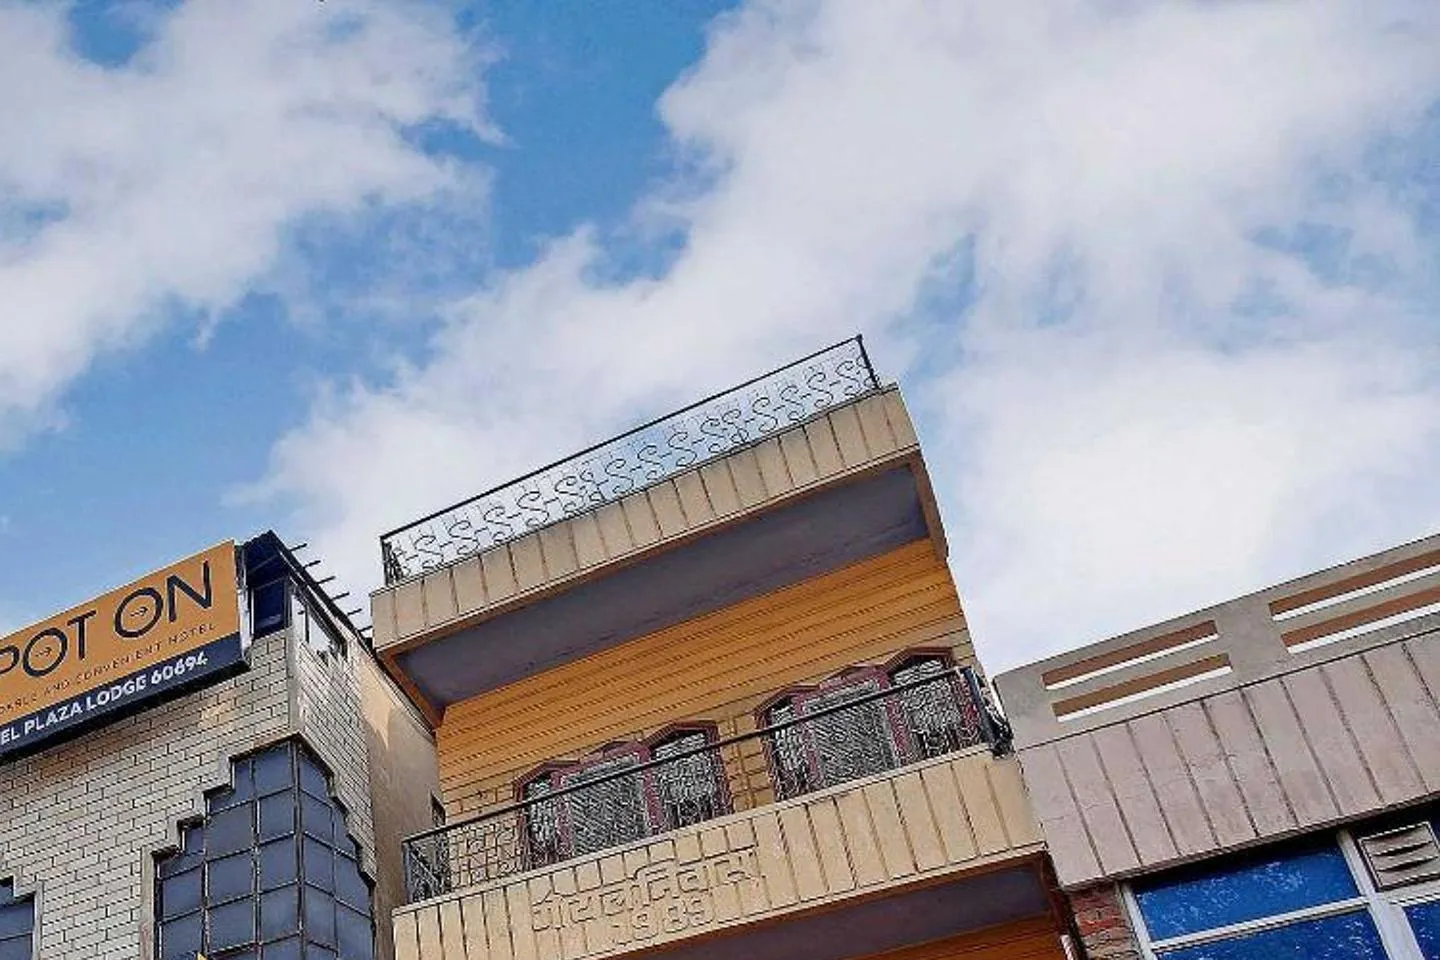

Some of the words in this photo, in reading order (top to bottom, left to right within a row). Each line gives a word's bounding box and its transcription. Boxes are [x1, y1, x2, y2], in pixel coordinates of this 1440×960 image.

[114, 560, 212, 638] ON
[24, 702, 84, 734] PLAZA
[86, 677, 147, 710] LODGE
[150, 651, 209, 685] 60694
